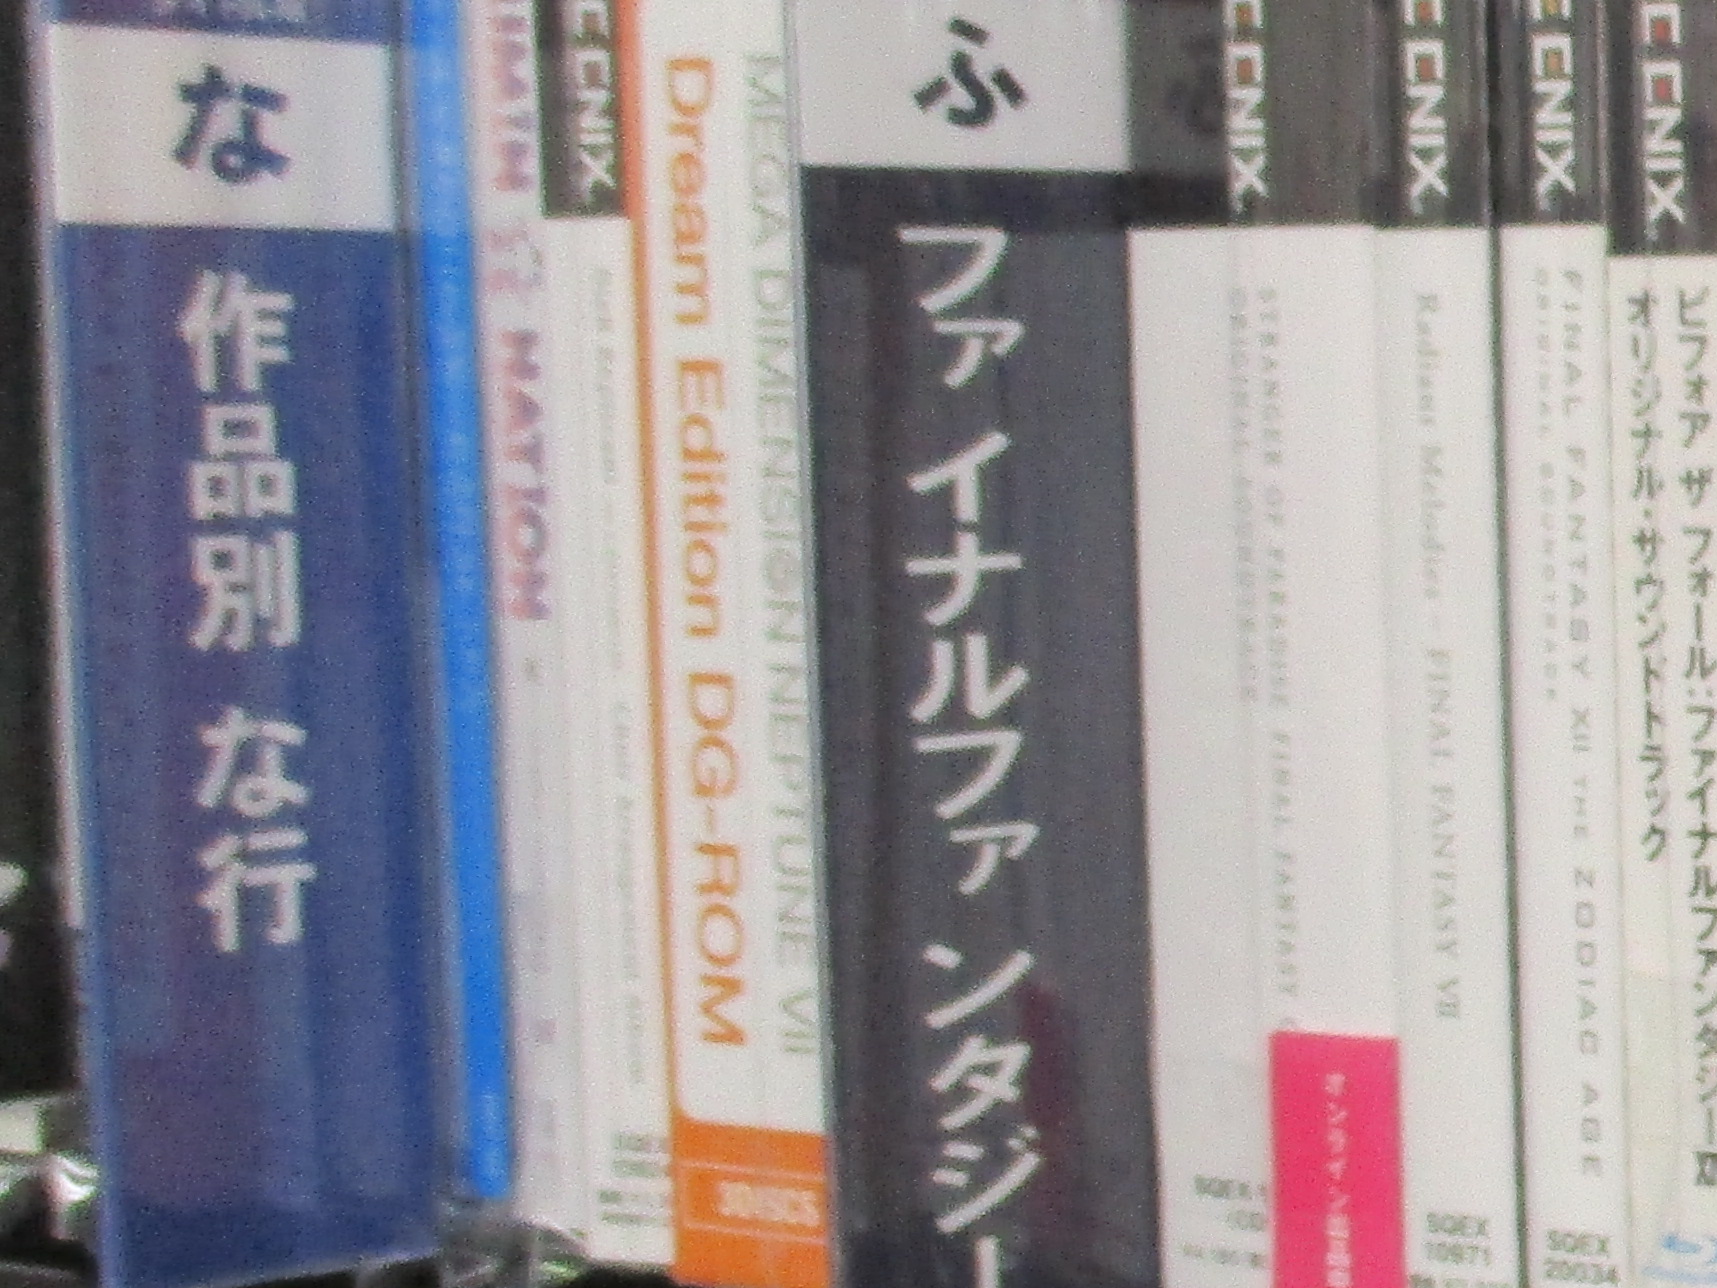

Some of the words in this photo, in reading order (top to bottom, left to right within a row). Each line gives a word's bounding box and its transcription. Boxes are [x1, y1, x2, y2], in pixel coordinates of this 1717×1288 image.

[172, 63, 290, 184] な
[568, 32, 618, 194] ENIX
[742, 52, 790, 242] MEGA
[913, 18, 1027, 130] ふ
[1227, 40, 1270, 213] ENIX
[1403, 32, 1451, 215] ENIX
[1528, 31, 1581, 214] ENIX
[1641, 59, 1690, 239] ENIX
[665, 57, 716, 329] Dream
[177, 269, 300, 652] 作品別
[675, 357, 732, 638] Edition
[1678, 466, 1714, 508] ザ
[199, 707, 317, 952] な行
[685, 667, 748, 1049] DG-ROM
